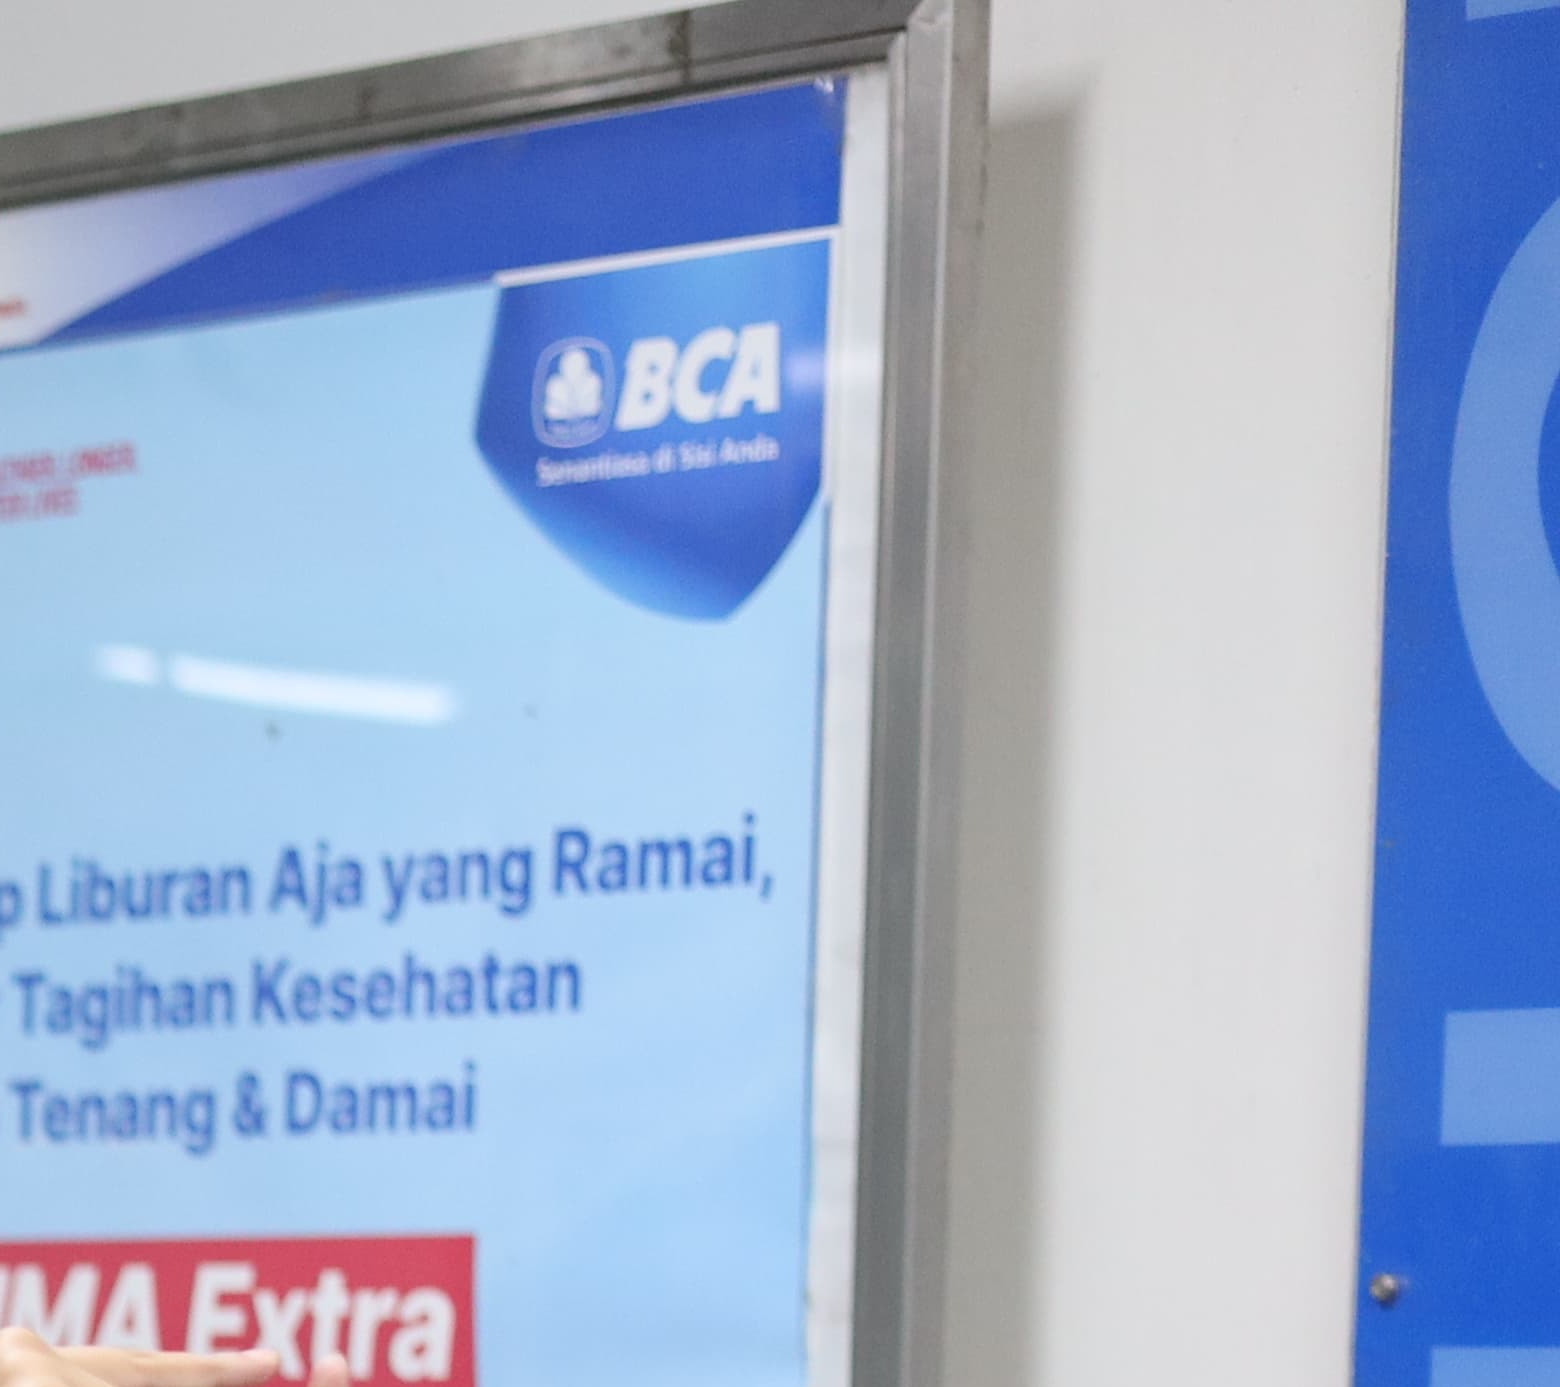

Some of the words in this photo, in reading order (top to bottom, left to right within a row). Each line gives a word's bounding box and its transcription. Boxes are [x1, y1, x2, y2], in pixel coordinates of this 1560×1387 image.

[614, 320, 781, 432] BCA
[37, 856, 253, 927] Liburan
[267, 840, 365, 927] Aja
[382, 845, 534, 926] yang
[552, 810, 774, 901] Ramai,
[12, 963, 236, 1052] Tagihan
[251, 951, 583, 1027] Kesehatan
[8, 1077, 215, 1158] Tenang
[232, 1070, 267, 1138] &
[283, 1060, 477, 1136] Damai
[184, 1260, 457, 1381] Extra
